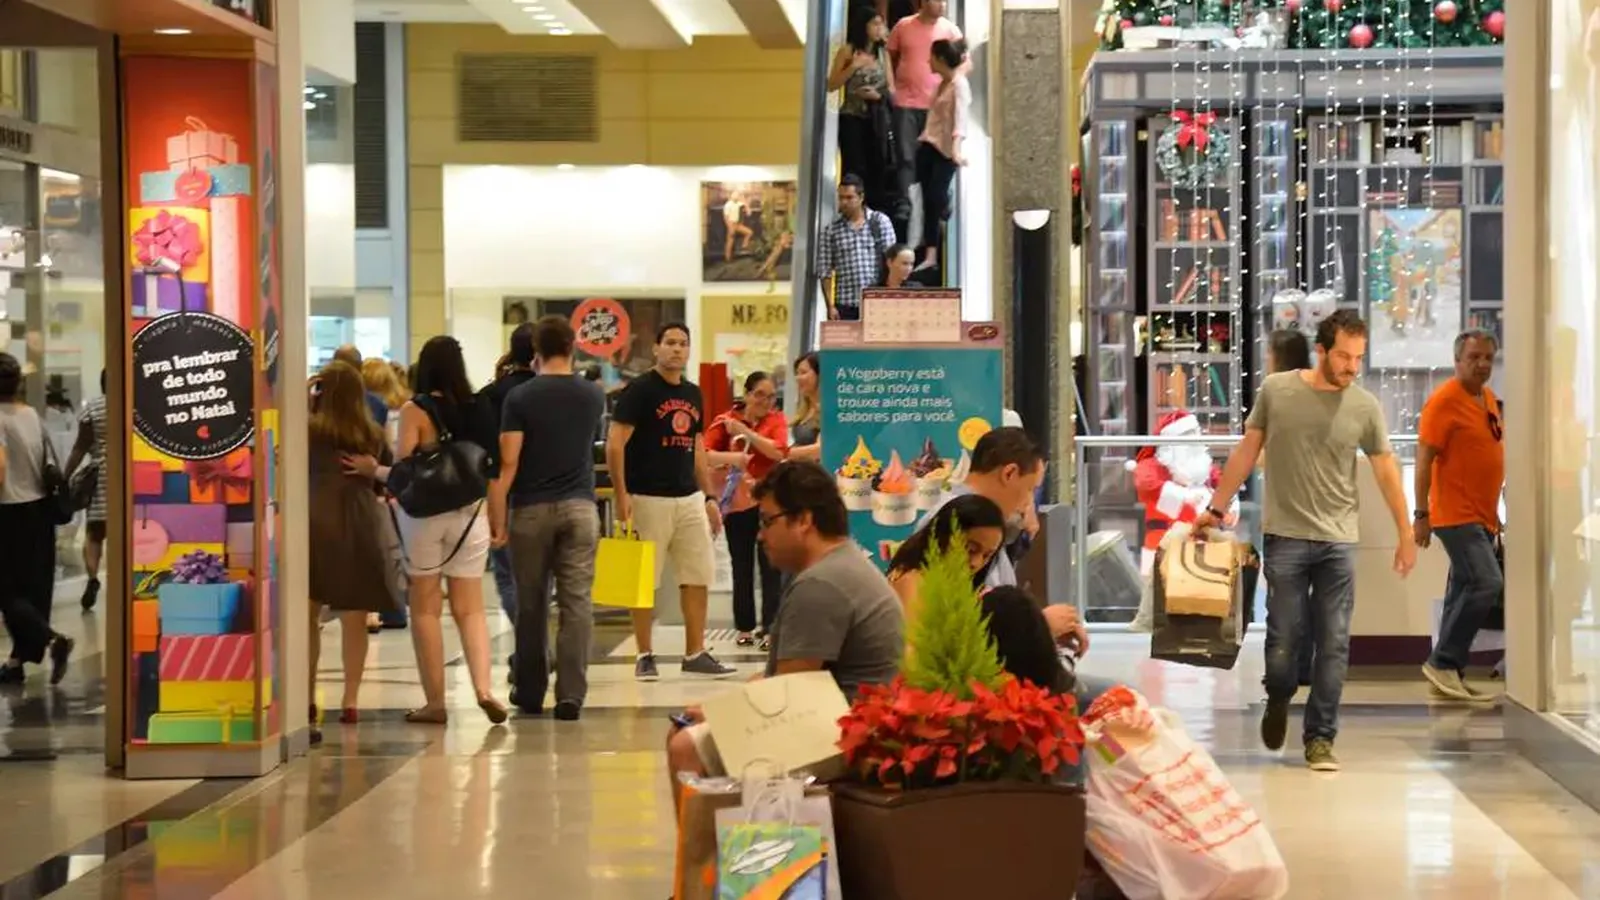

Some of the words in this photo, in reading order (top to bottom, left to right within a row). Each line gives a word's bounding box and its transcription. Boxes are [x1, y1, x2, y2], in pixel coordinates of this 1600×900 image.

[142, 360, 172, 377] pra
[173, 350, 239, 369] lembrar
[162, 374, 184, 389] de
[186, 369, 226, 385] todo
[837, 367, 846, 379] A
[850, 367, 914, 382] Yogoberry
[916, 366, 945, 379] está
[167, 386, 228, 406] mundo
[837, 382, 854, 394] de
[856, 384, 885, 394] cara
[888, 384, 919, 394] nova
[922, 385, 931, 394] e
[837, 397, 880, 408] trouxe
[882, 396, 918, 407] ainda
[920, 396, 953, 407] mais
[165, 412, 189, 425] no
[191, 401, 236, 421] Natal
[837, 411, 890, 422] sabores
[892, 413, 923, 423] para
